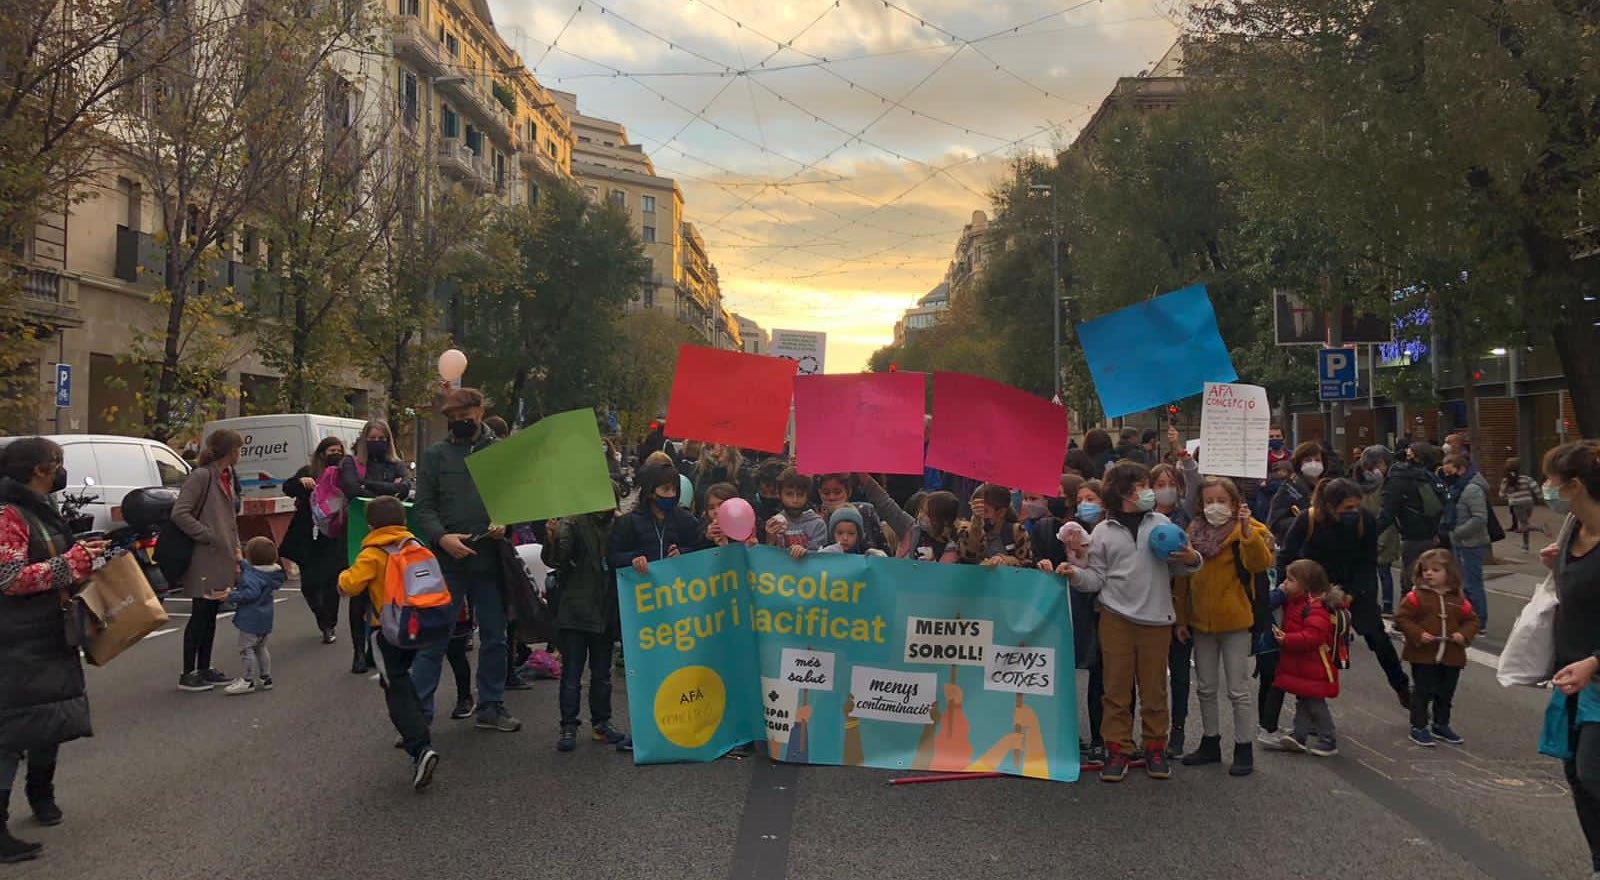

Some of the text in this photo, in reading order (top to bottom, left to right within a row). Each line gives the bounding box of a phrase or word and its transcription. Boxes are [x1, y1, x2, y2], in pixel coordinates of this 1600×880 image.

[1327, 354, 1346, 378] P
[60, 370, 68, 386] P
[1207, 385, 1233, 398] AFA
[240, 441, 289, 458] arquet
[635, 569, 739, 613] Entorn
[639, 598, 887, 652] segur i acificat
[915, 619, 980, 637] MENYS
[908, 643, 983, 661] SOROLL!
[994, 651, 1047, 670] MENYS
[795, 656, 822, 668] més
[787, 669, 827, 684] salut
[991, 671, 1050, 688] COTXES
[680, 688, 704, 705] AFA
[869, 679, 919, 703] menys
[856, 696, 930, 716] contaminació
